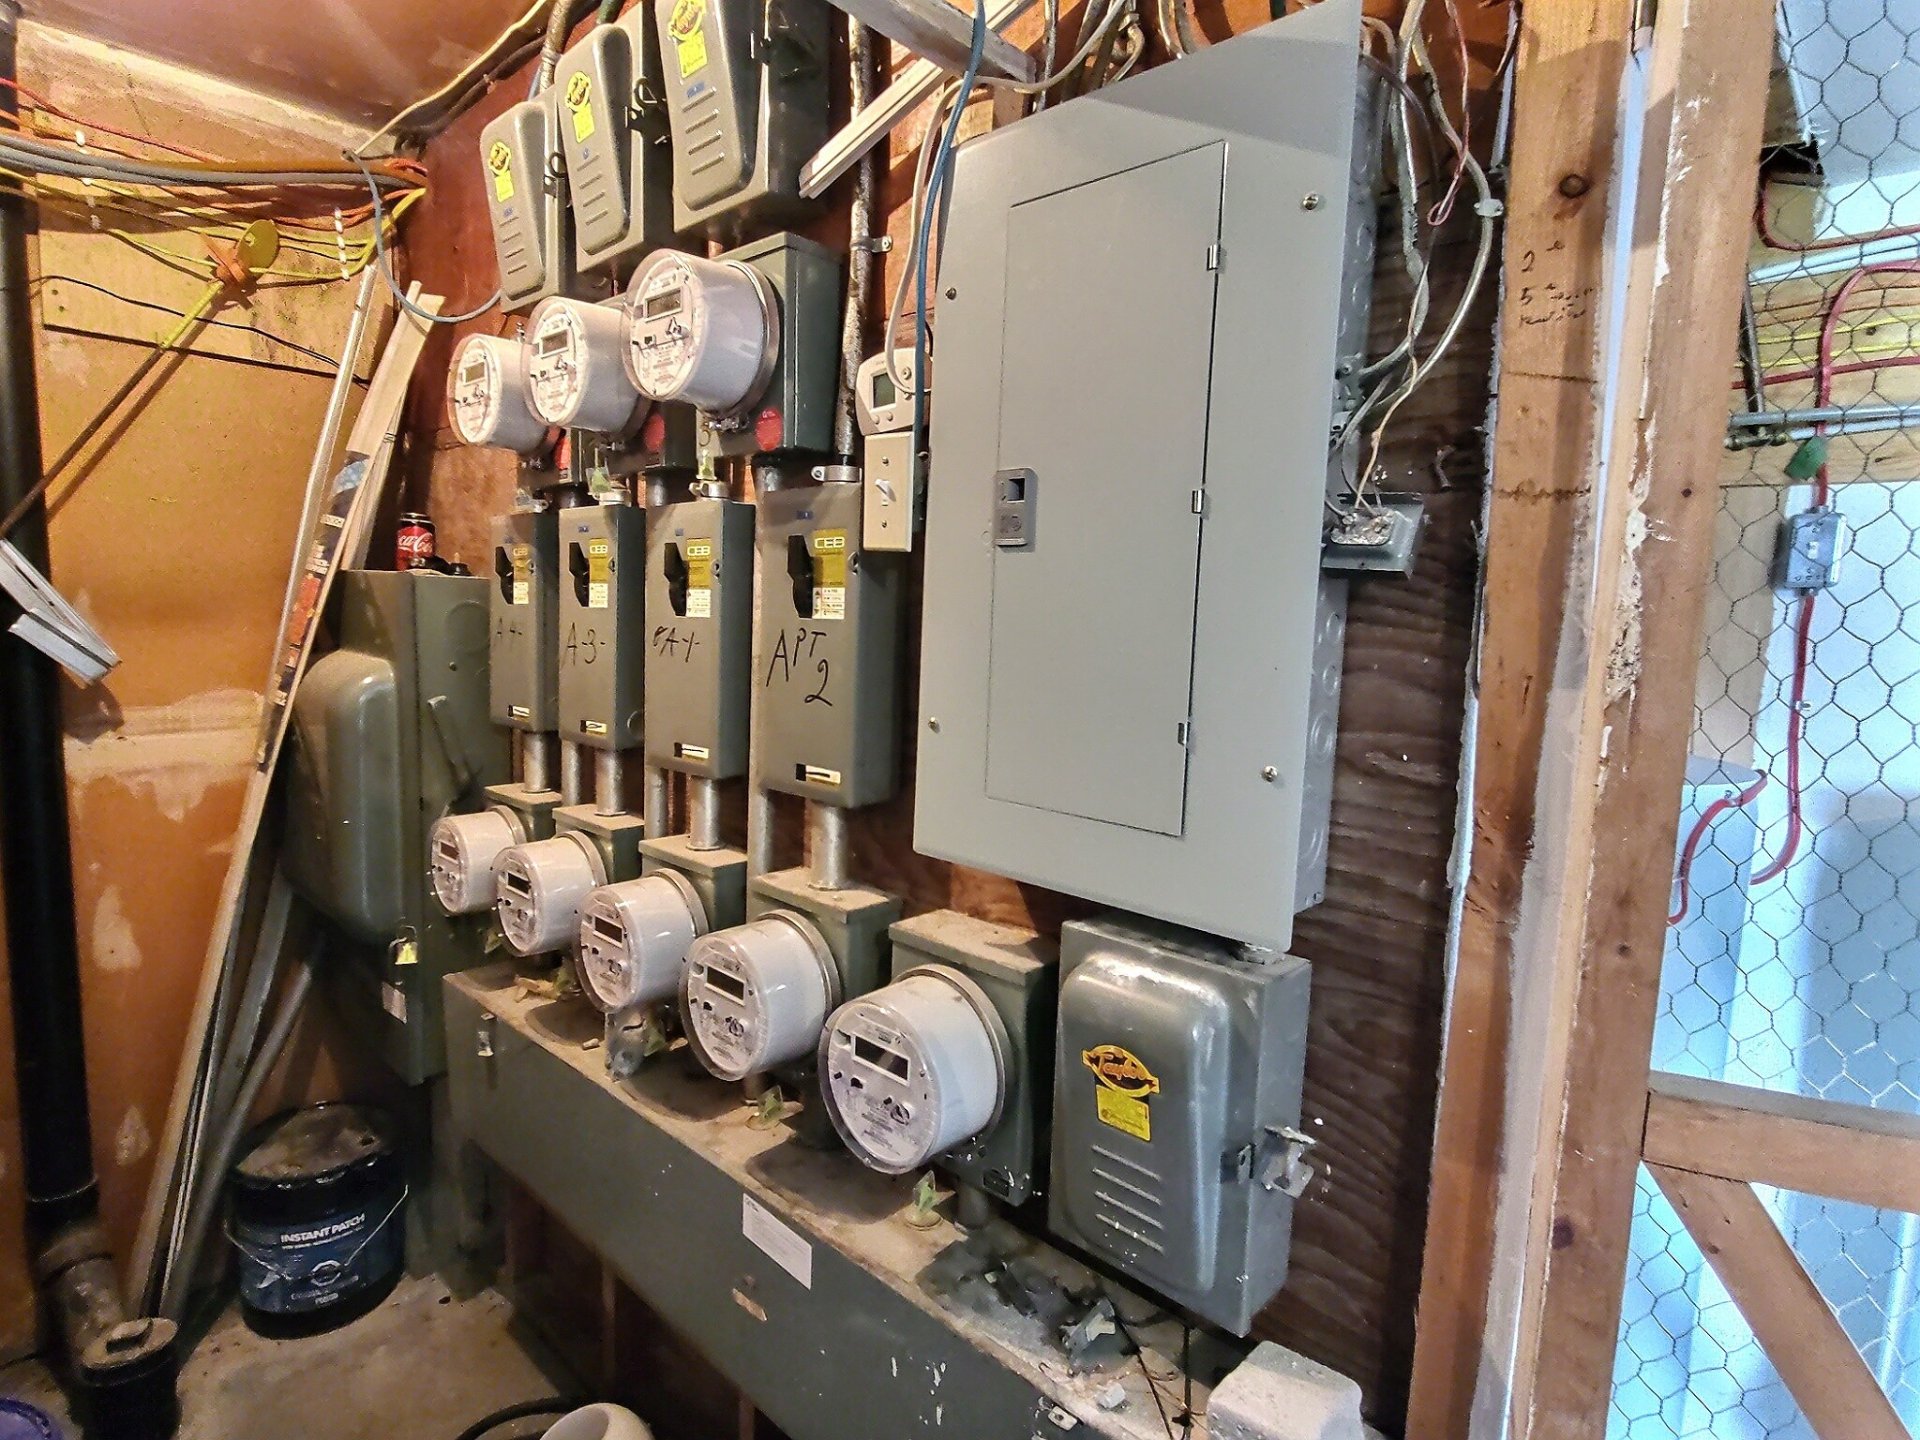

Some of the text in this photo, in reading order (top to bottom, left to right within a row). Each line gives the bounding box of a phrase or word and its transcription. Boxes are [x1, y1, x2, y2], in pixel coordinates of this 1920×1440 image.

[766, 627, 827, 687] APT
[804, 658, 833, 707] 2
[281, 1213, 365, 1243] INSTANT PATCH
